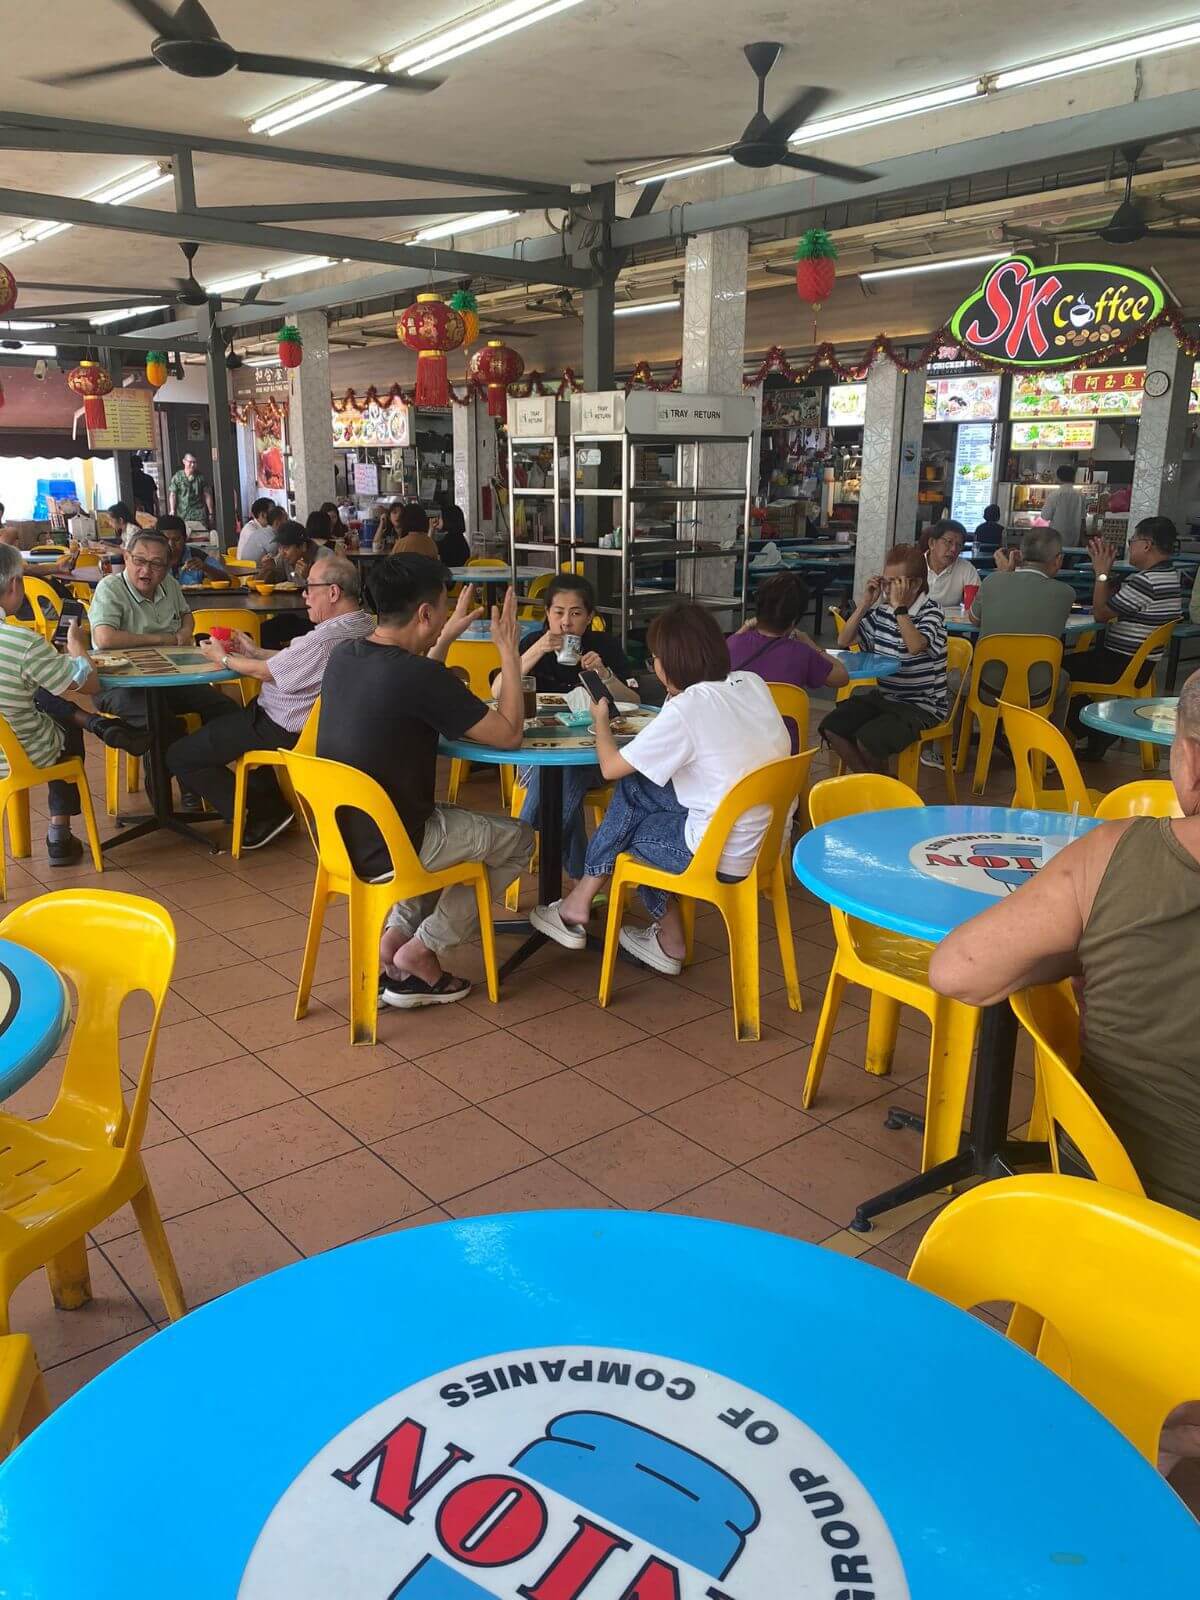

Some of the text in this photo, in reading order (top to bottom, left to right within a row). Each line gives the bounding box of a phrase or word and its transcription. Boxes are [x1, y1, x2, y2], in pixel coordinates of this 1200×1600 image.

[966, 261, 1063, 359] SK
[932, 361, 965, 370] CHICKEN
[671, 409, 721, 419] TRAY RETURN
[925, 834, 1003, 851] COMPANIES
[439, 1359, 696, 1408] COMPANIES
[717, 1407, 779, 1445] OF
